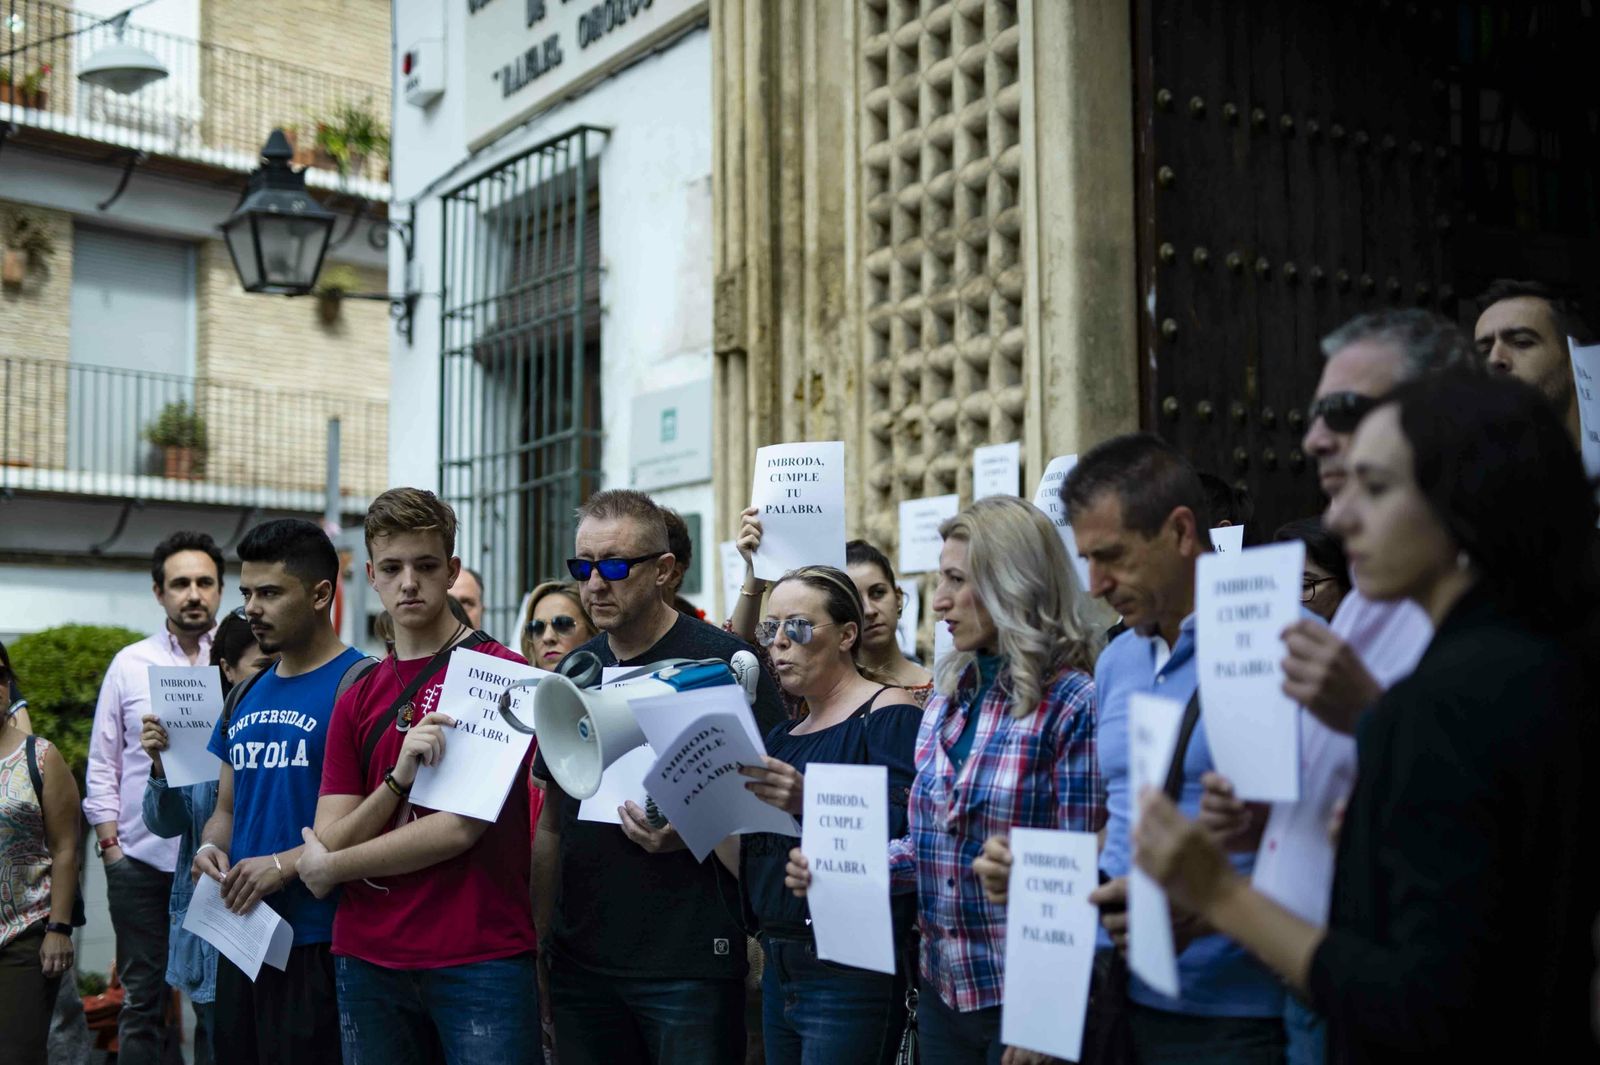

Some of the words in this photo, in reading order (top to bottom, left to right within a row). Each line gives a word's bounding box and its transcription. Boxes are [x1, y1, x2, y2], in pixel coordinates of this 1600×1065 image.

[768, 457, 824, 468] IMBRODA,
[770, 473, 819, 482] CUMPLE
[786, 489, 801, 498] TU
[765, 505, 823, 514] PALABRA
[1049, 503, 1058, 512] TU
[160, 679, 206, 689] IMBRODA,
[468, 667, 530, 695] IMBROA,
[165, 693, 204, 702] CUMPLE
[469, 686, 520, 709] CUME
[179, 707, 192, 716] TU
[482, 708, 498, 721] TU
[166, 720, 212, 728] PALABRA
[228, 710, 317, 740] UNIVERSIDAD
[454, 719, 509, 744] PALABRA
[229, 738, 309, 771] OYOLA
[661, 726, 724, 780] IMBRODA,
[673, 738, 726, 784] CUMPLE
[695, 759, 712, 775] TU
[684, 761, 744, 805] PALABRA
[817, 793, 869, 809] IMBRODA,
[819, 815, 863, 830] CUMPLE
[833, 838, 847, 851] TU
[815, 858, 867, 875] PALABRA
[1026, 876, 1074, 896] CUMPLE
[1022, 925, 1075, 946] PALABRA
